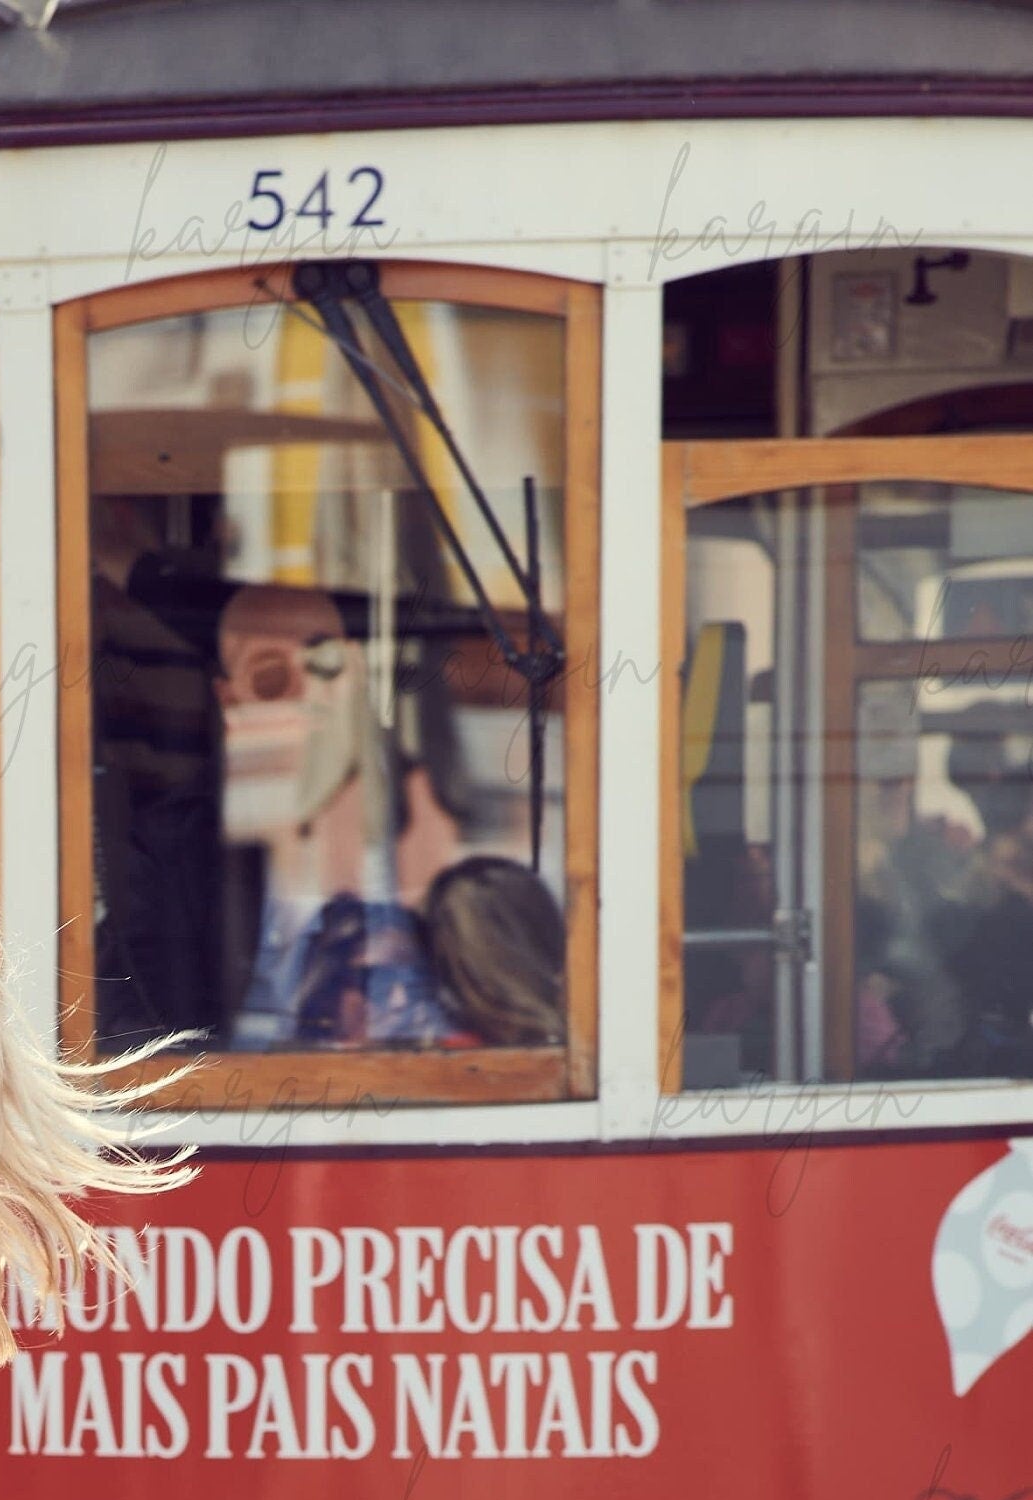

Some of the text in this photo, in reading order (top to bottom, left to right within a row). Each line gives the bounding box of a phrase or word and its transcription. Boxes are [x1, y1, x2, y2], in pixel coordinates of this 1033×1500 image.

[247, 167, 384, 231] 542
[289, 1224, 620, 1333] PRECISA
[633, 1222, 733, 1330] DE
[8, 1350, 660, 1460] MAIS PAIS NATAIS
